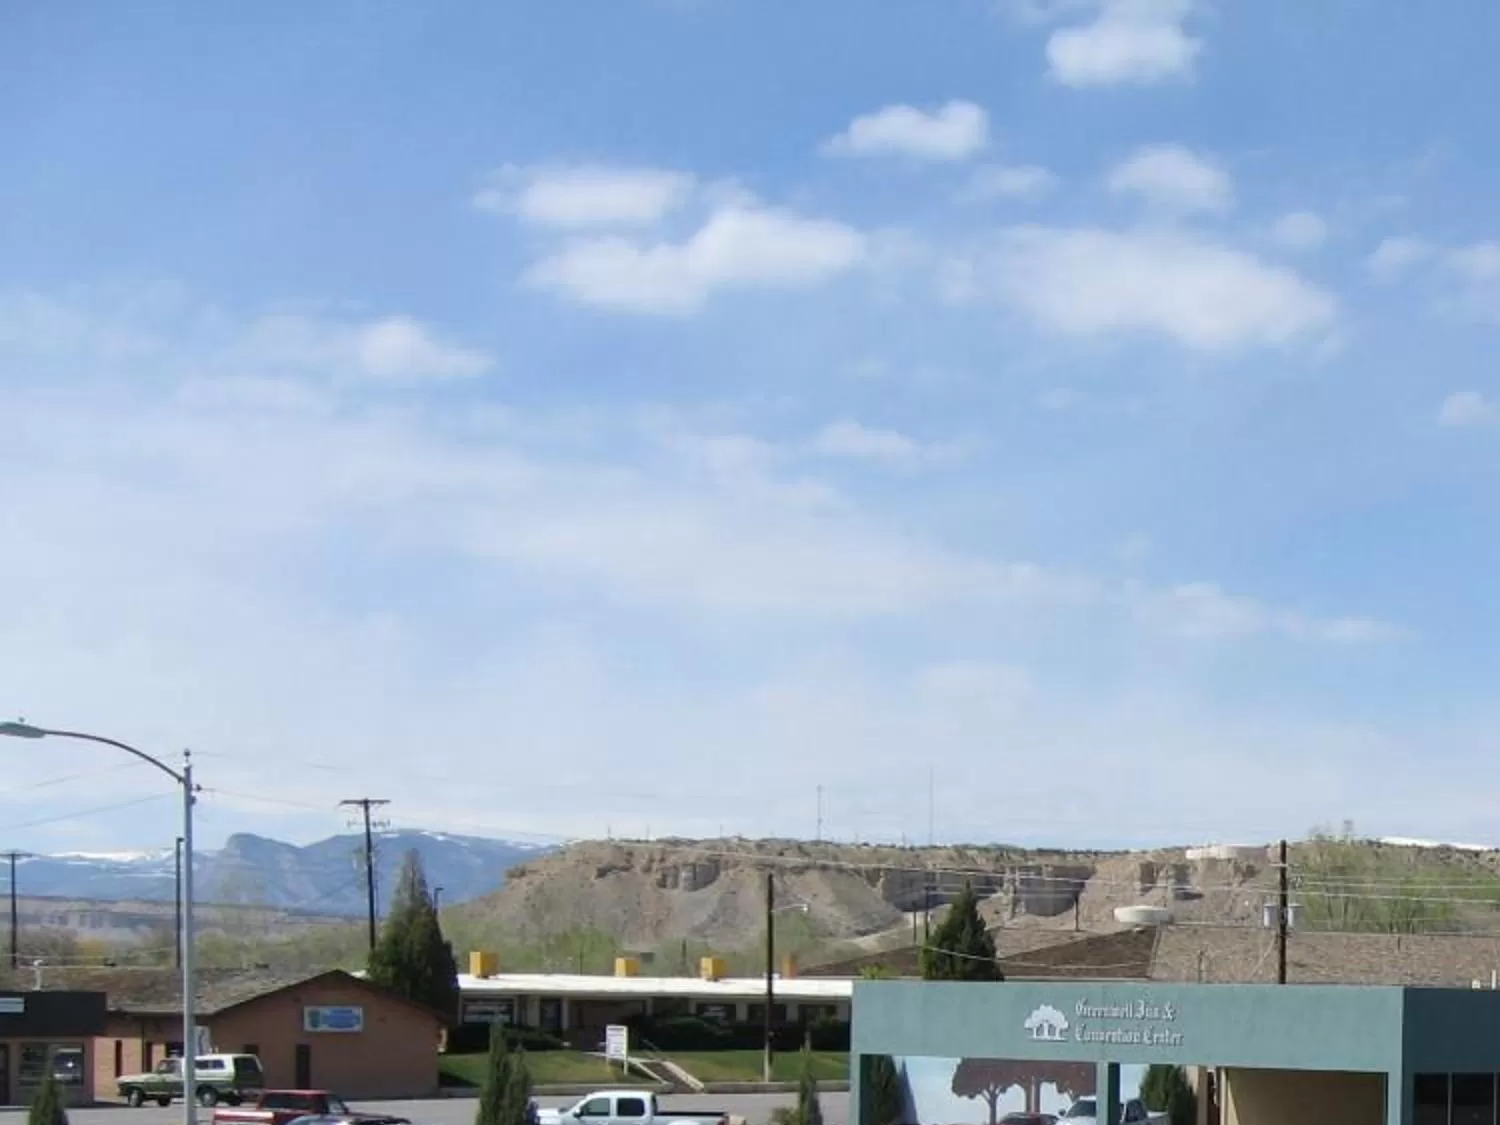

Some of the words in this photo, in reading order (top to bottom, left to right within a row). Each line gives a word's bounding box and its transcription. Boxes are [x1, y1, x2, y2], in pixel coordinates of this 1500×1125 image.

[1076, 997, 1133, 1019] Greenwell
[1136, 1000, 1159, 1020] Inn
[1162, 1001, 1176, 1021] &
[1076, 1023, 1140, 1043] Convention
[1143, 1025, 1184, 1046] Center
